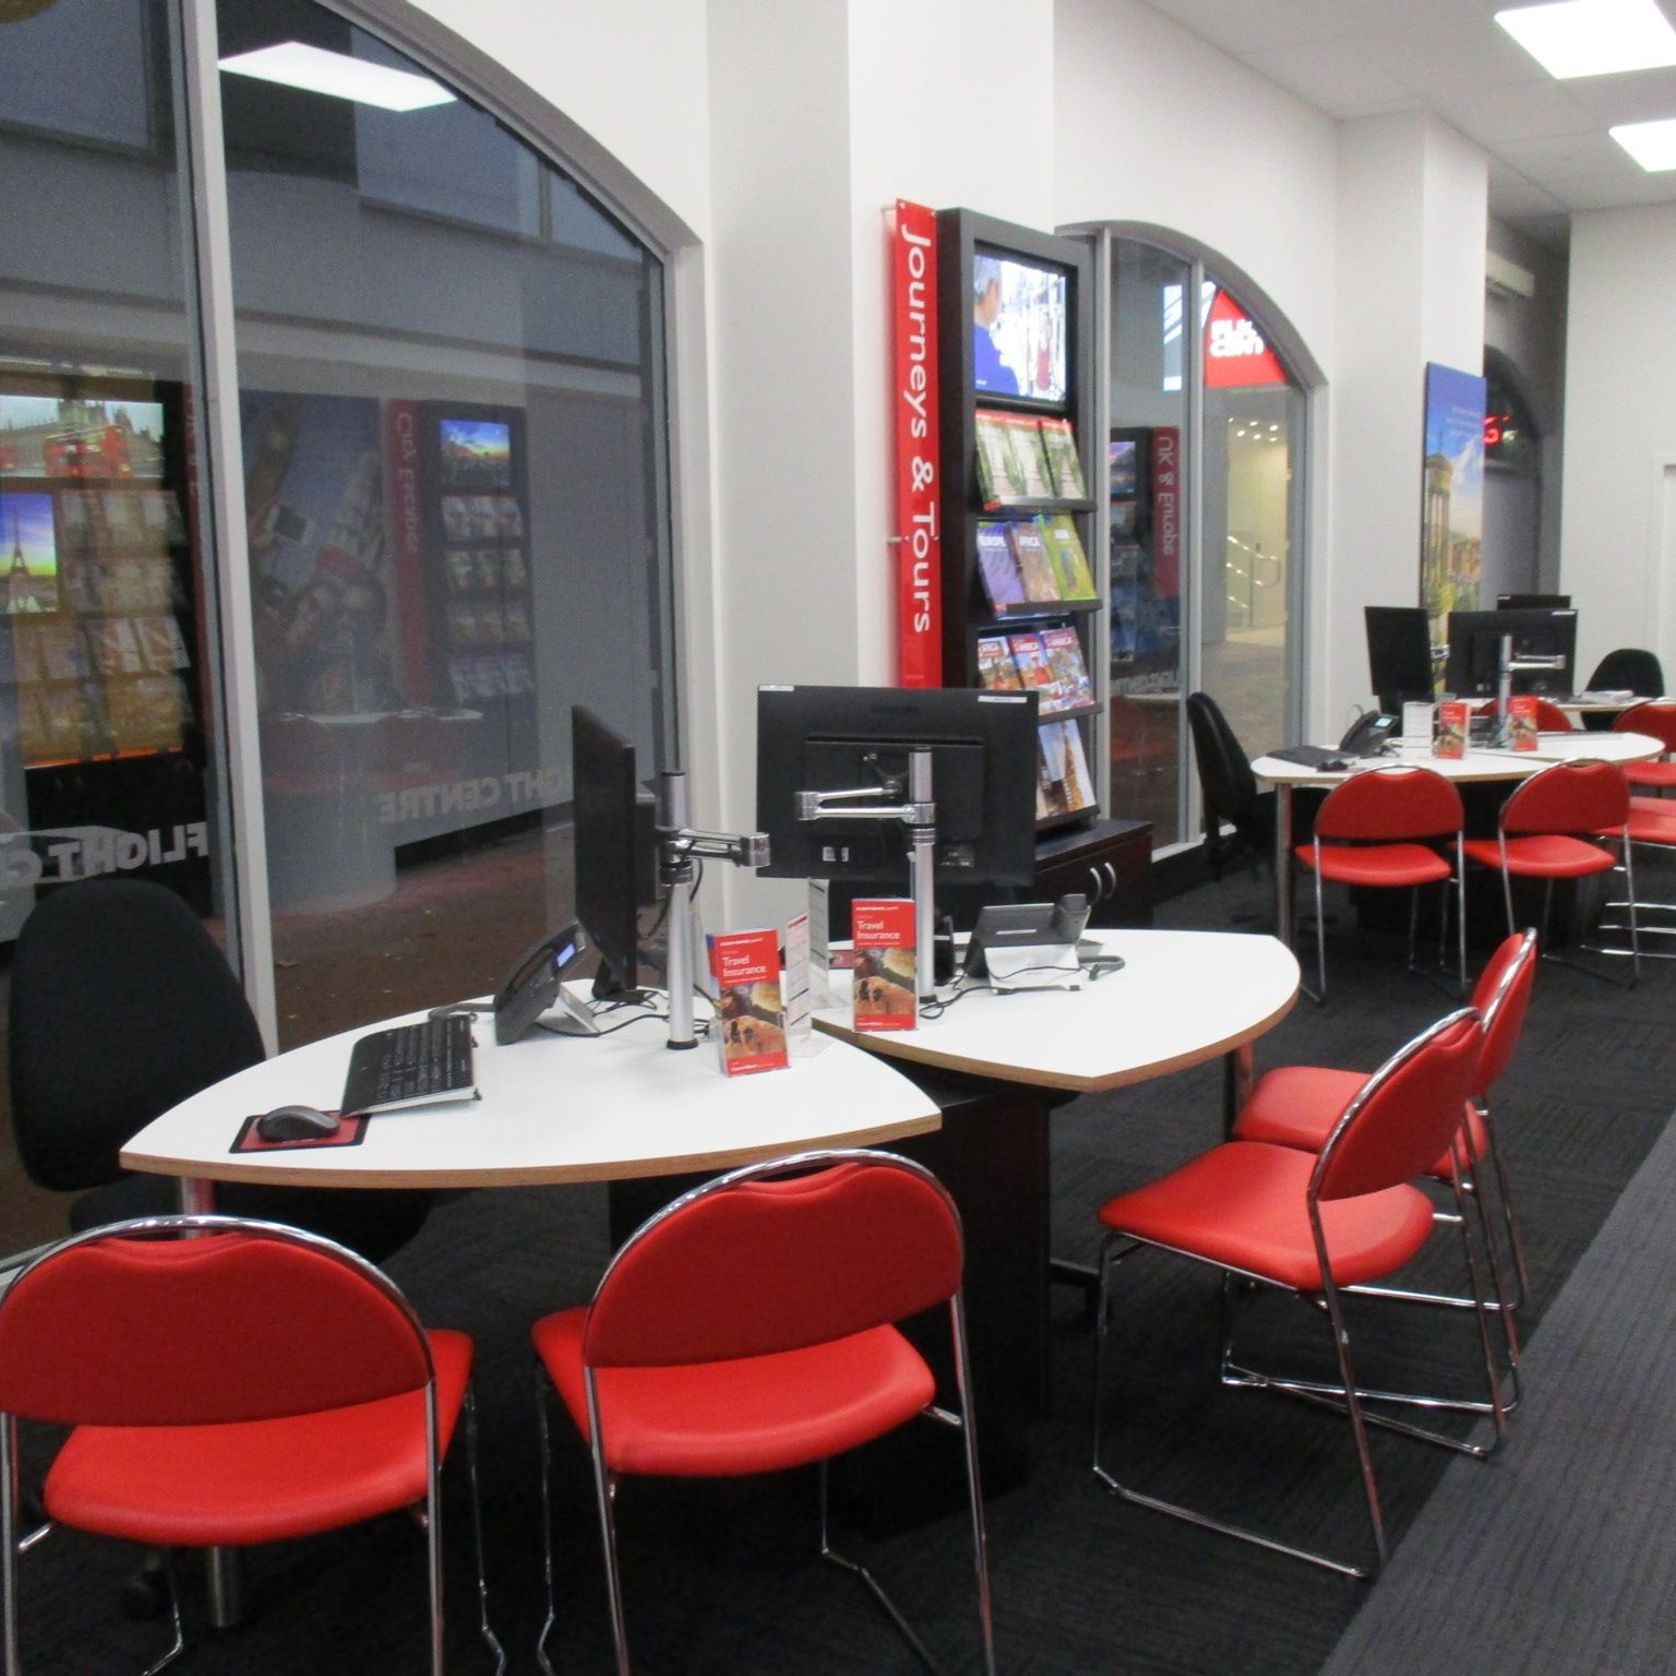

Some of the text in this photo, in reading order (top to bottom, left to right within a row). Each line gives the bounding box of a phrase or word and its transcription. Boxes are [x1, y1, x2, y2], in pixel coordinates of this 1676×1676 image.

[902, 224, 936, 634] Journeys & Tours
[857, 920, 884, 930] Travel
[857, 931, 900, 939] Insurance
[723, 955, 750, 966] Travel
[723, 965, 767, 977] Insurance
